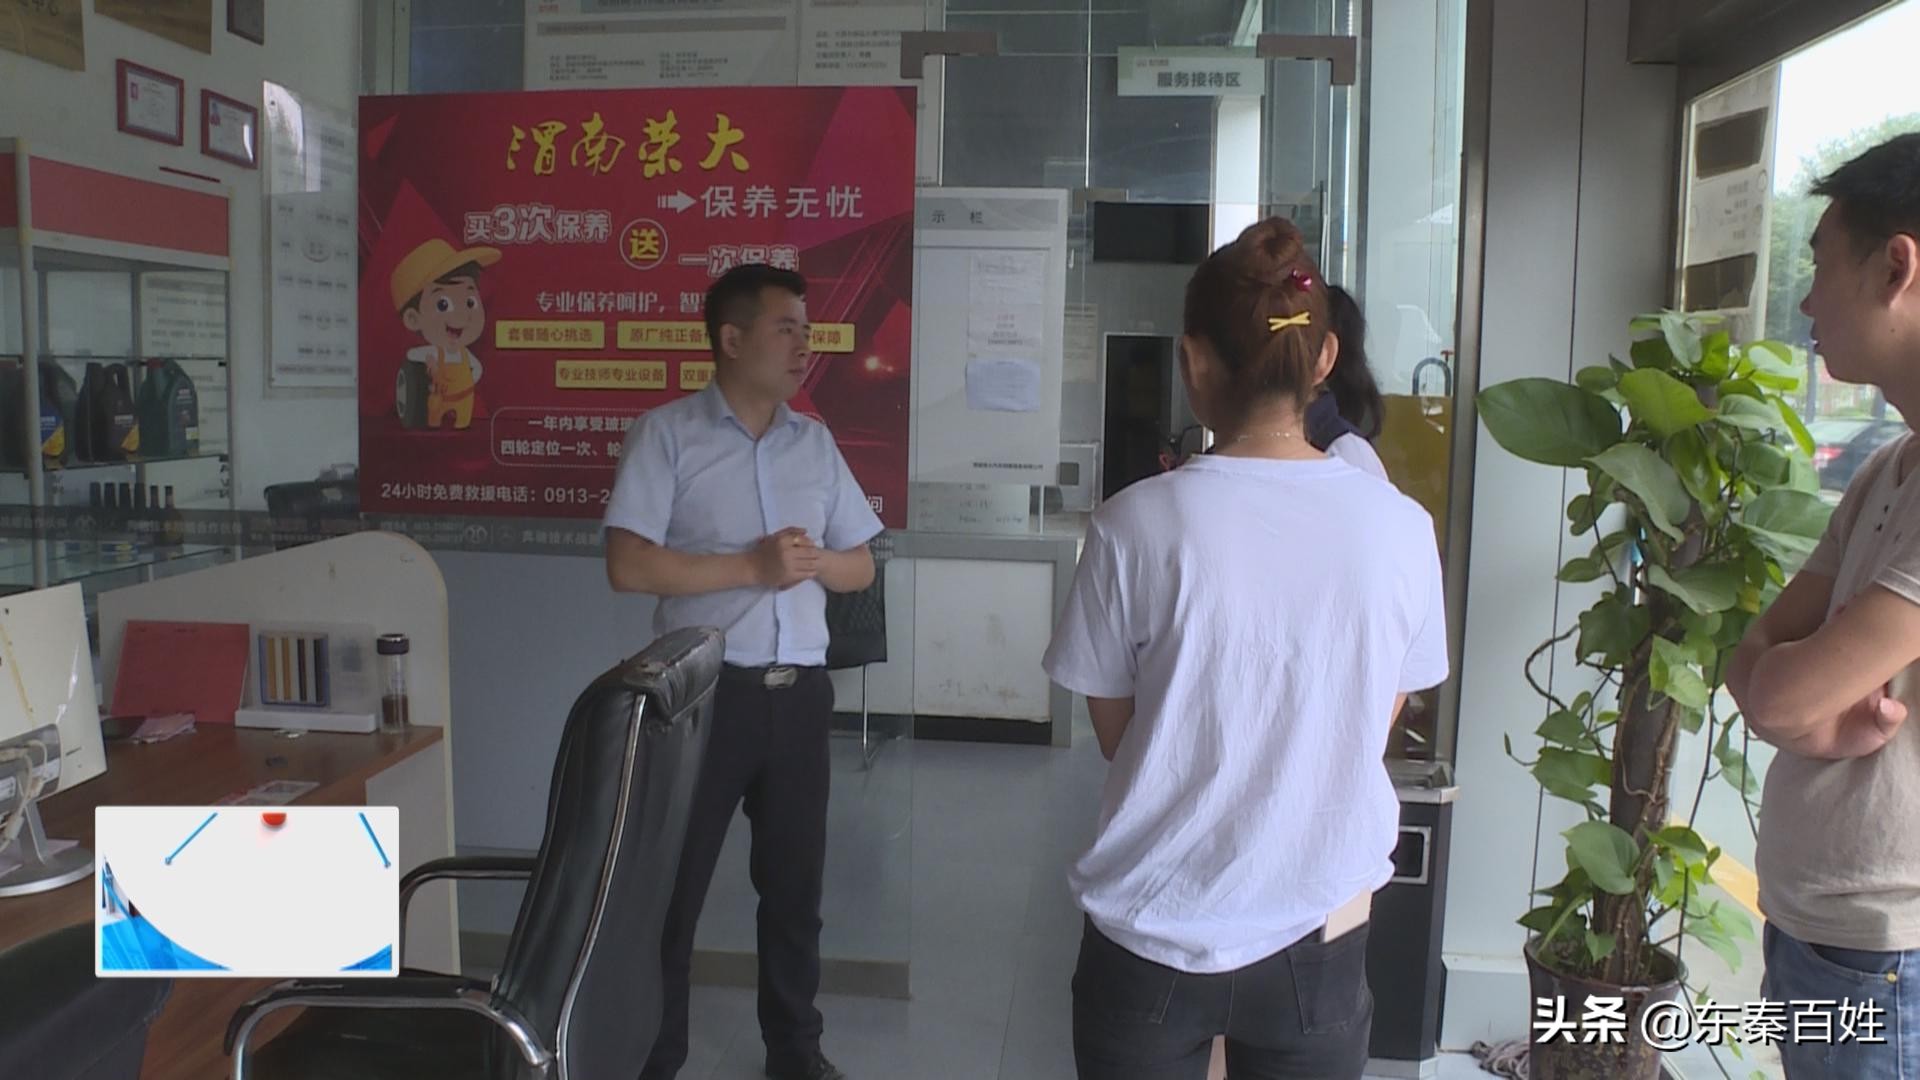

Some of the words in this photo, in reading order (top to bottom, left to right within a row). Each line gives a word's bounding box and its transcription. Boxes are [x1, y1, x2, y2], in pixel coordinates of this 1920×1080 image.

[1157, 71, 1241, 88] 服务接待区
[507, 110, 750, 178] 渭南荣大
[701, 185, 864, 220] 保养无忧
[465, 204, 612, 243] 买3次保养
[628, 228, 661, 261] 送
[507, 327, 593, 343] 套餐随心挑选
[558, 368, 665, 383] 专业技师专业设备
